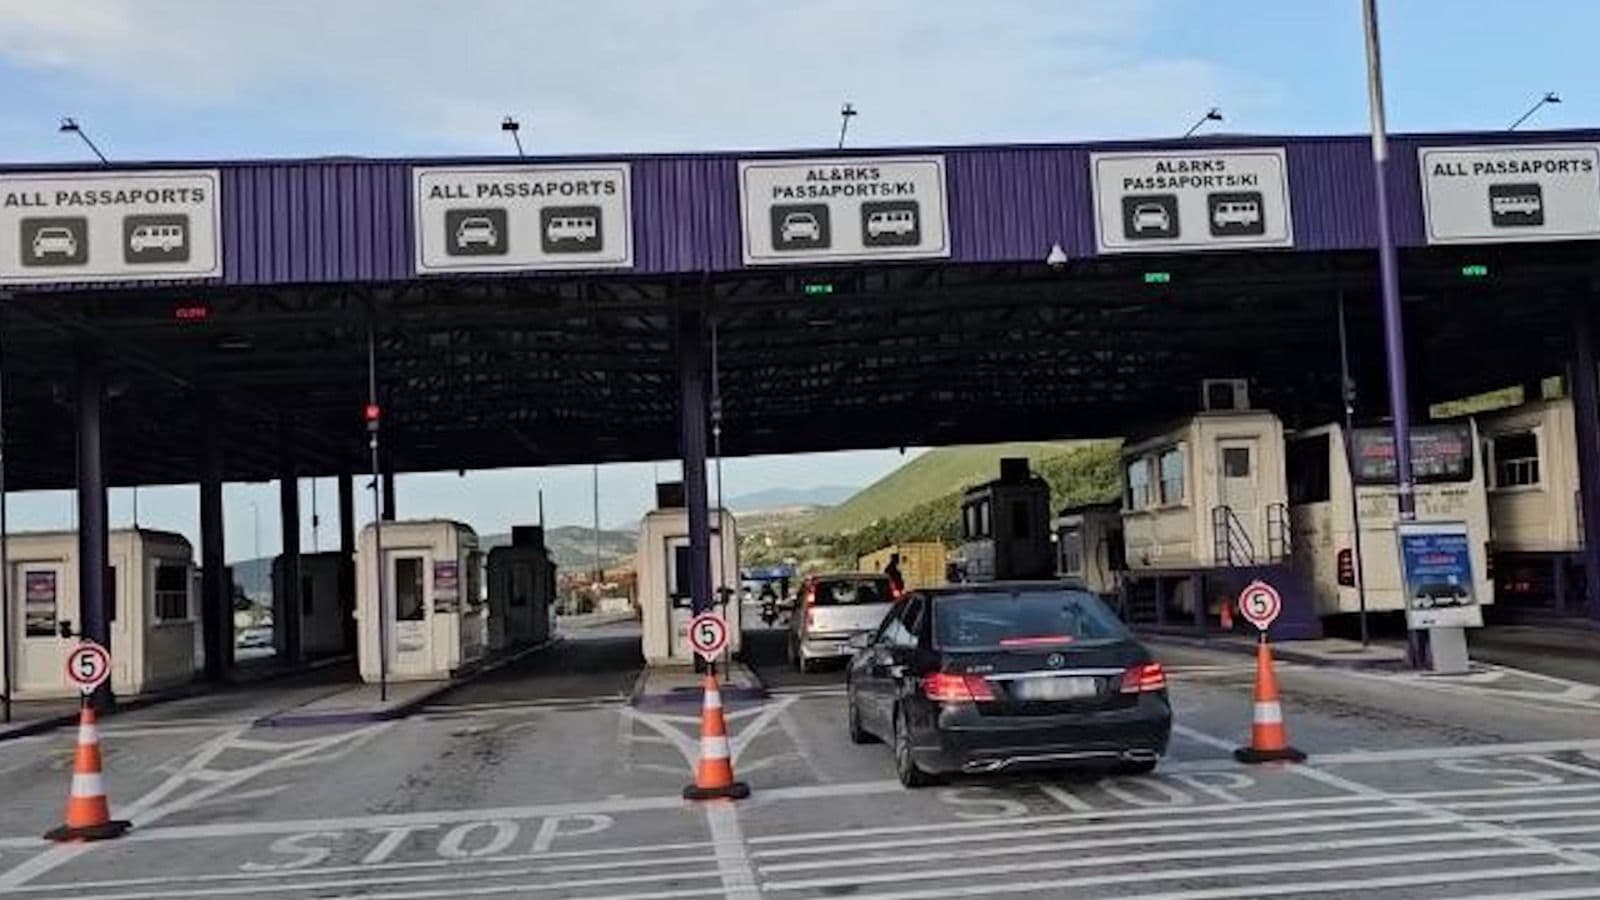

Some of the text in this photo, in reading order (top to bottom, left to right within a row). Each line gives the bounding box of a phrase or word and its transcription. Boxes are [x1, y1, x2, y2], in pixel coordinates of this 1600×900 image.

[805, 167, 880, 182] AL&RKS
[1155, 160, 1226, 174] AL&RKS
[1433, 159, 1593, 176] ALL PASSAPORTS
[429, 180, 616, 199] ALL PASSAPORTS
[772, 182, 915, 199] PASSAPORTS/KI
[1122, 174, 1258, 190] PASSAPORTS/KI
[4, 187, 205, 208] ALL PASSAPORTS
[1253, 593, 1267, 614] 5
[702, 624, 716, 646] 5
[81, 654, 95, 677] 5
[239, 813, 615, 872] STOP
